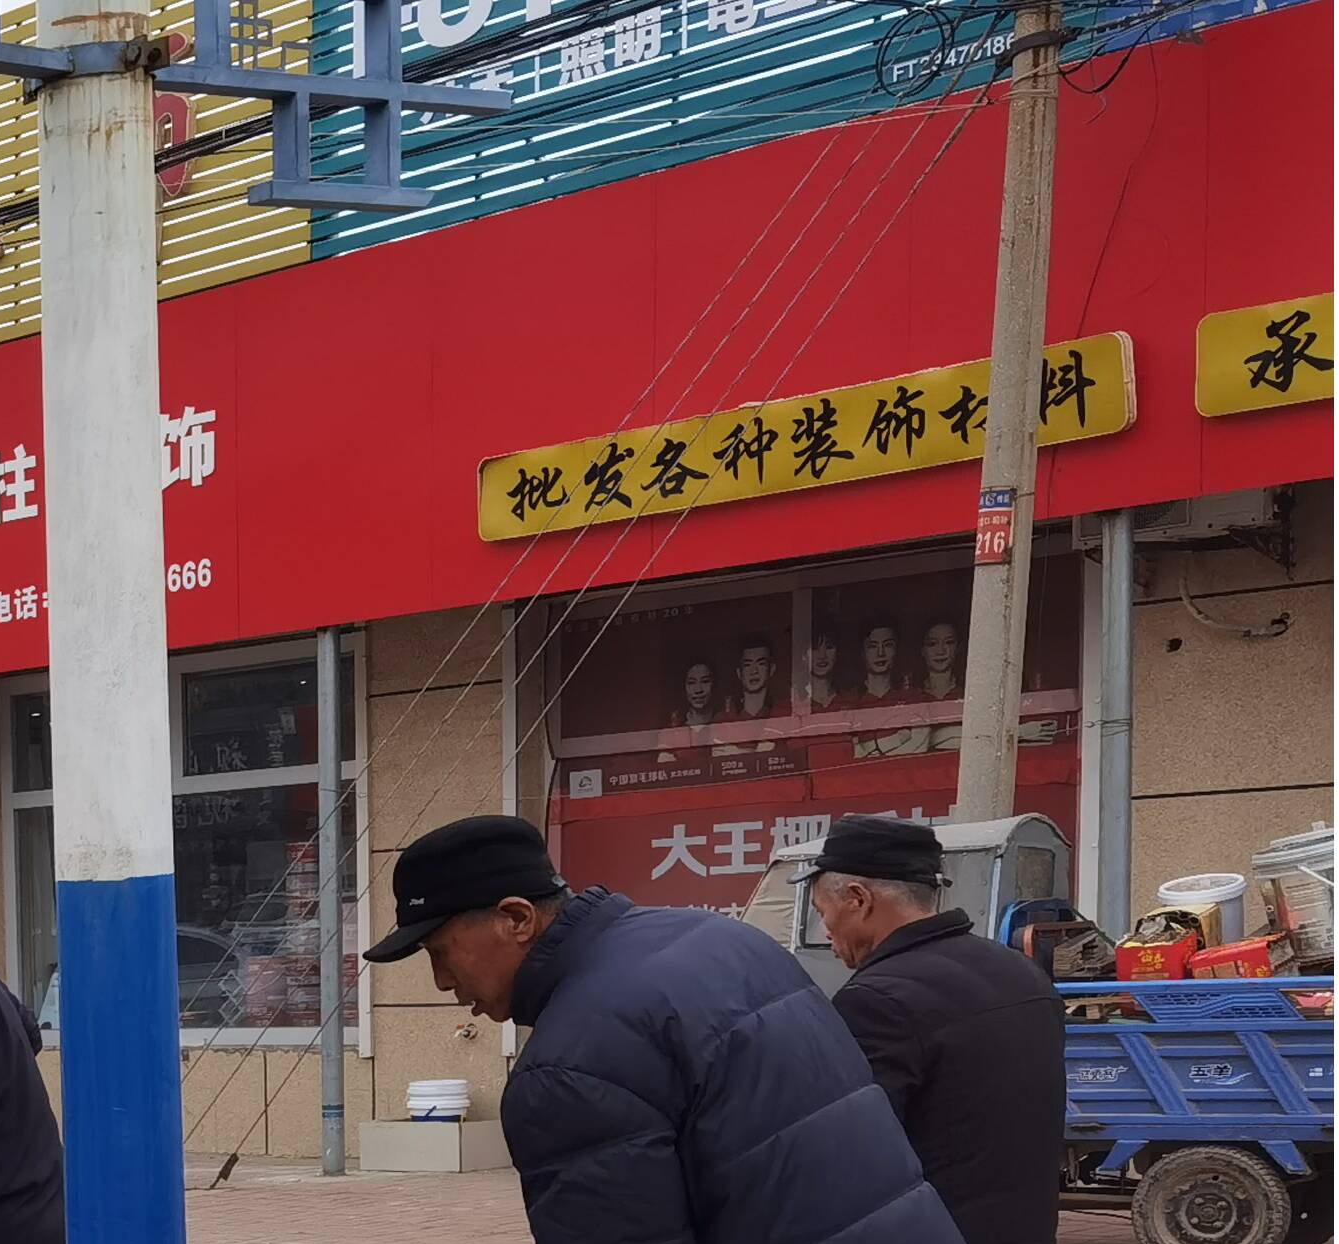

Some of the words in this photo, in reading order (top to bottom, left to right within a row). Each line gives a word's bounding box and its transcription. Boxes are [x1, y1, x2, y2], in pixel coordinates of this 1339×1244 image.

[506, 350, 1096, 522] 批发各种装饰材料
[1189, 1064, 1233, 1077] 五羊
